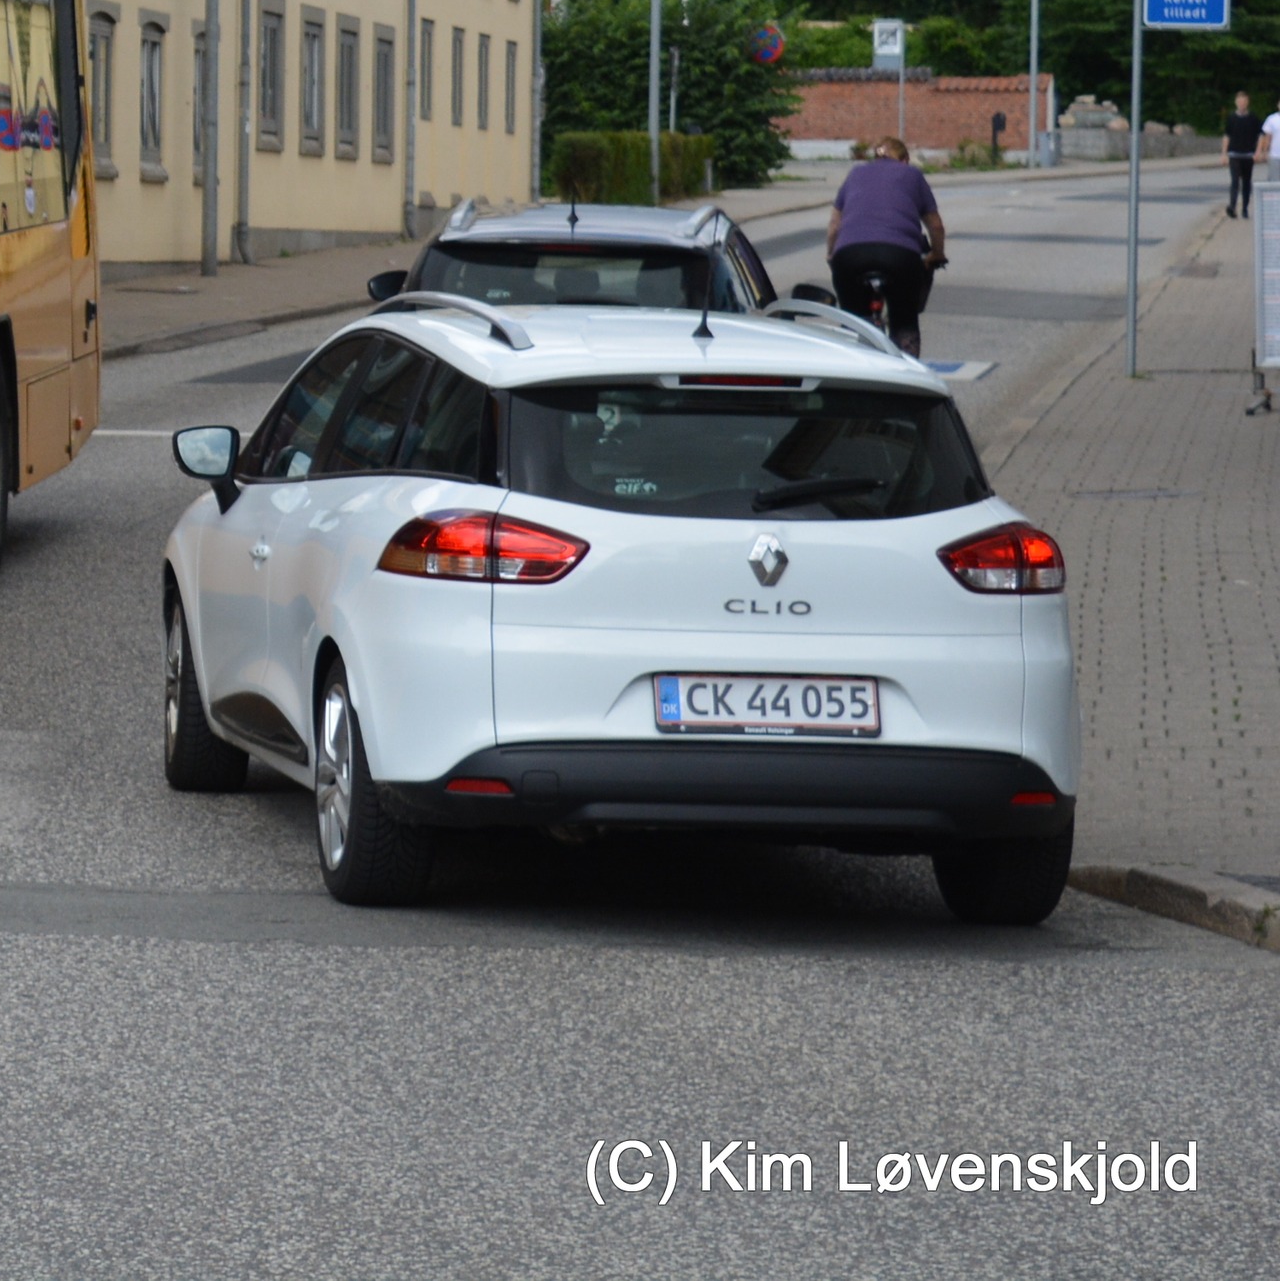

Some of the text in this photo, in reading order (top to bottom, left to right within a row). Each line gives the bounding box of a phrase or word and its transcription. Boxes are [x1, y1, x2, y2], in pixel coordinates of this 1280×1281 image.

[1163, 7, 1207, 19] tilladt
[724, 599, 811, 615] CLIO
[662, 683, 869, 719] DK CK 44 055
